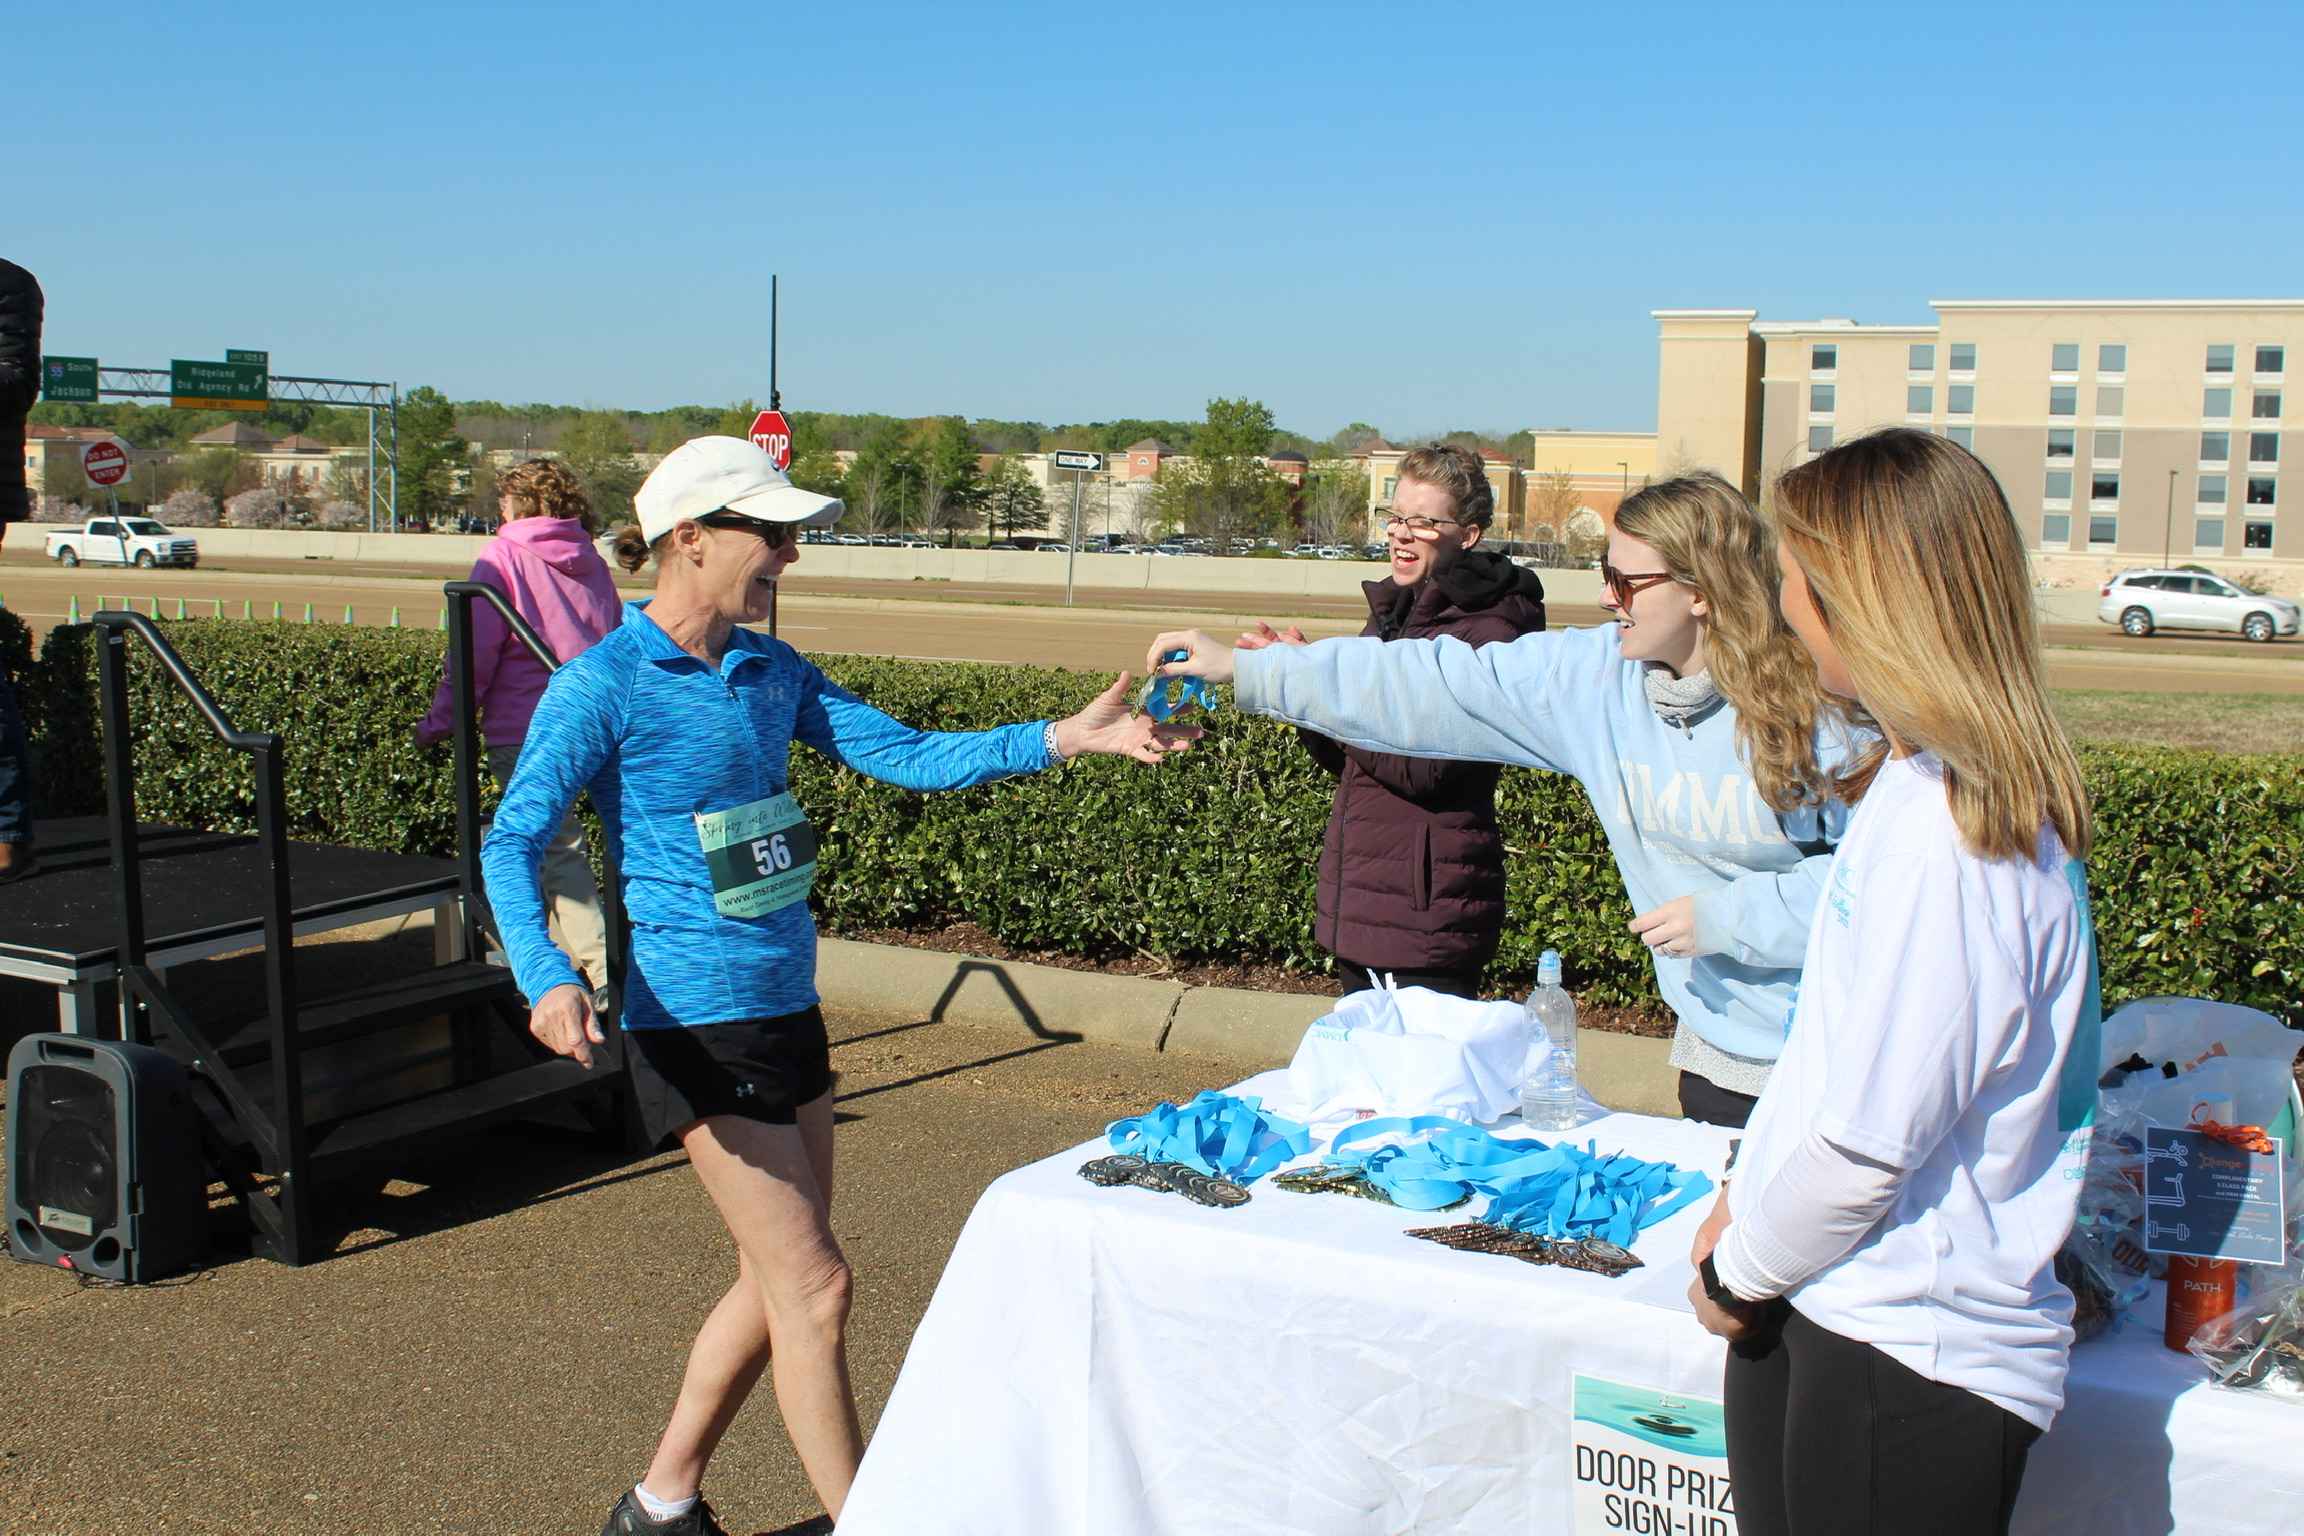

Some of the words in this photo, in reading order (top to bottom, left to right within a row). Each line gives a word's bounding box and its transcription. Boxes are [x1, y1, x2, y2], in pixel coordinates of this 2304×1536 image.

[88, 452, 100, 461] DO
[102, 448, 120, 458] NOT
[95, 468, 121, 479] ENTER
[751, 834, 791, 875] 56
[2184, 1280, 2221, 1293] PATH
[1576, 1444, 1656, 1497] DOOR
[1667, 1463, 1736, 1515] PRIZ
